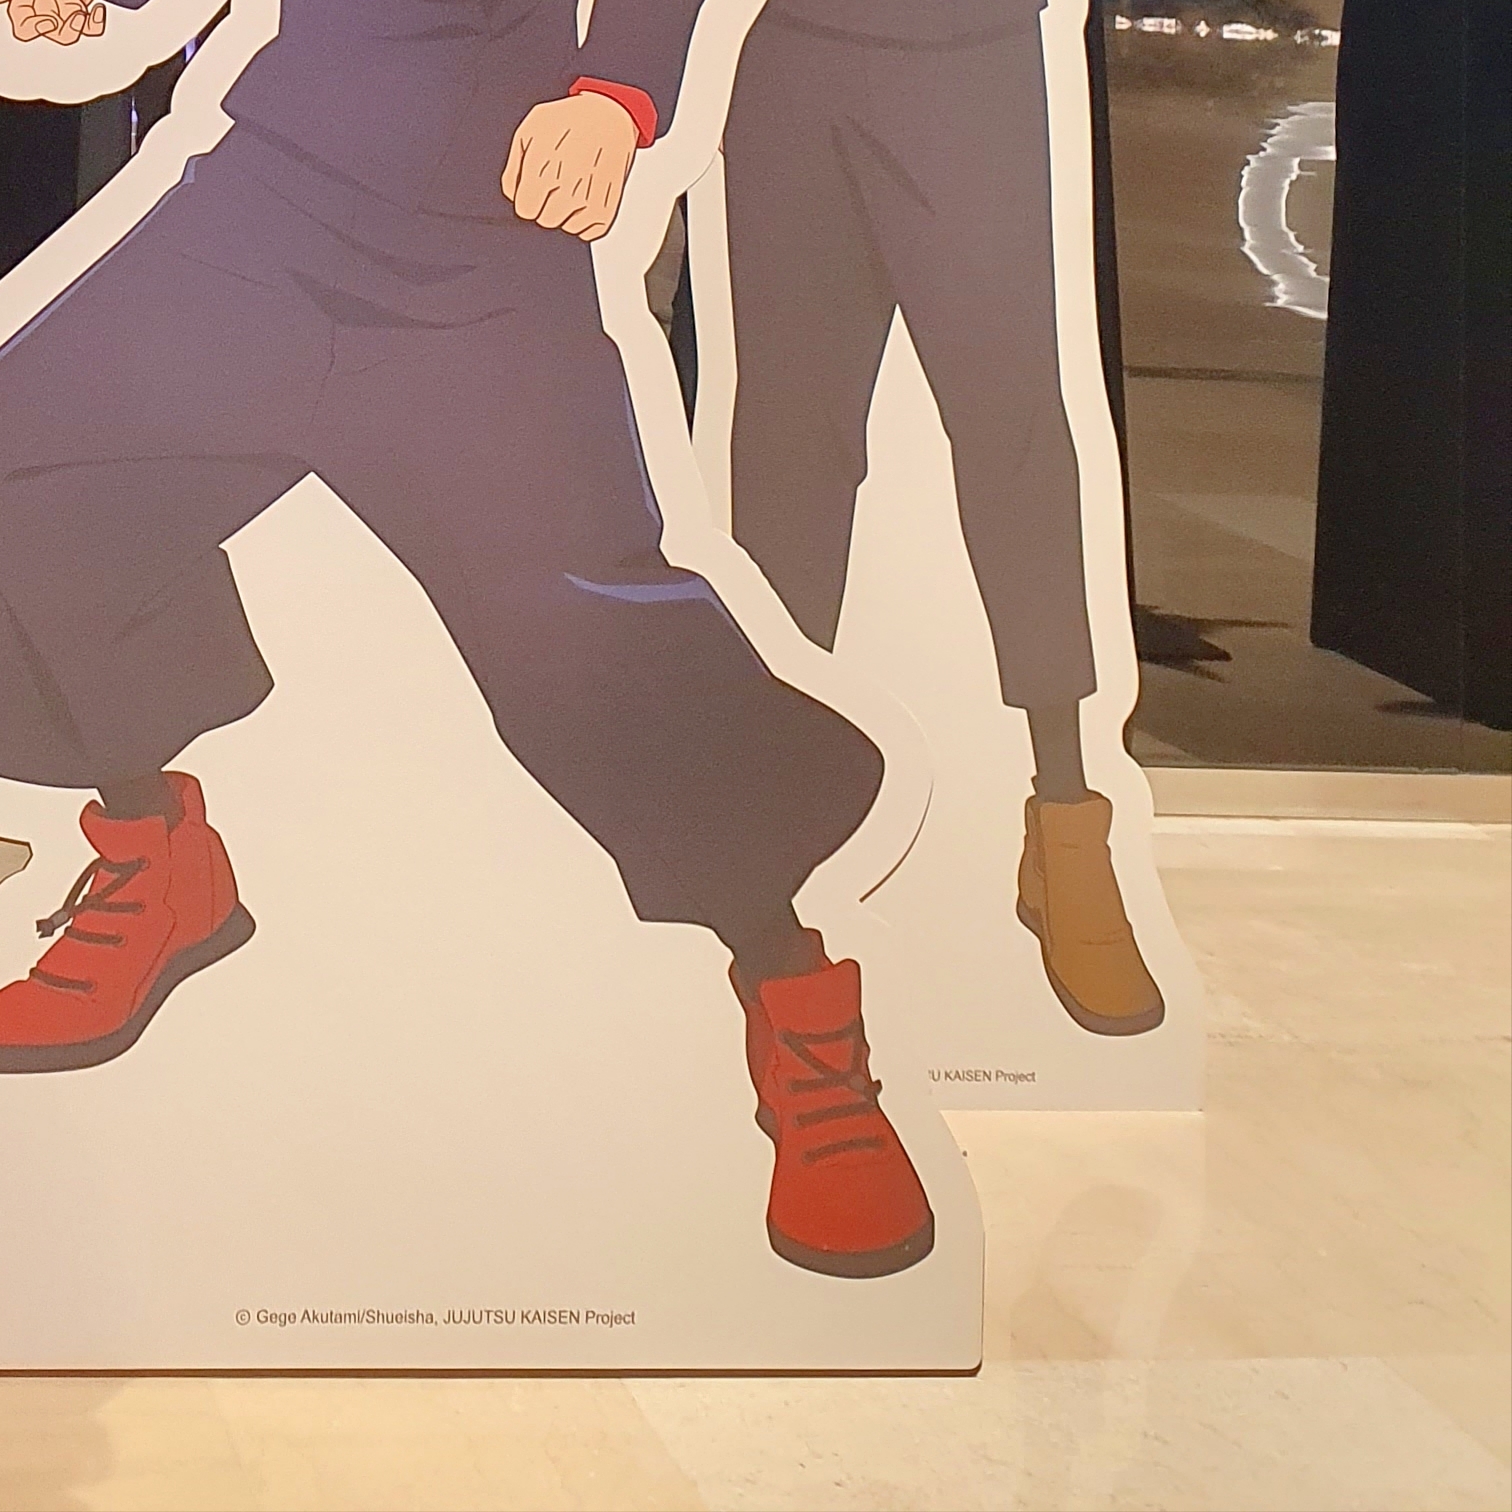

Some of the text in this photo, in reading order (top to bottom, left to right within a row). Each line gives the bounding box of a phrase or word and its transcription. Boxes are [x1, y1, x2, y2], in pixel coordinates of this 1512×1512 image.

[944, 1069, 992, 1082] KAISEN
[995, 1069, 1037, 1085] Project
[256, 1309, 297, 1327] Gege
[443, 1309, 516, 1325] JUJUTSU
[520, 1310, 581, 1325] KAISEN
[585, 1310, 637, 1328] Project
